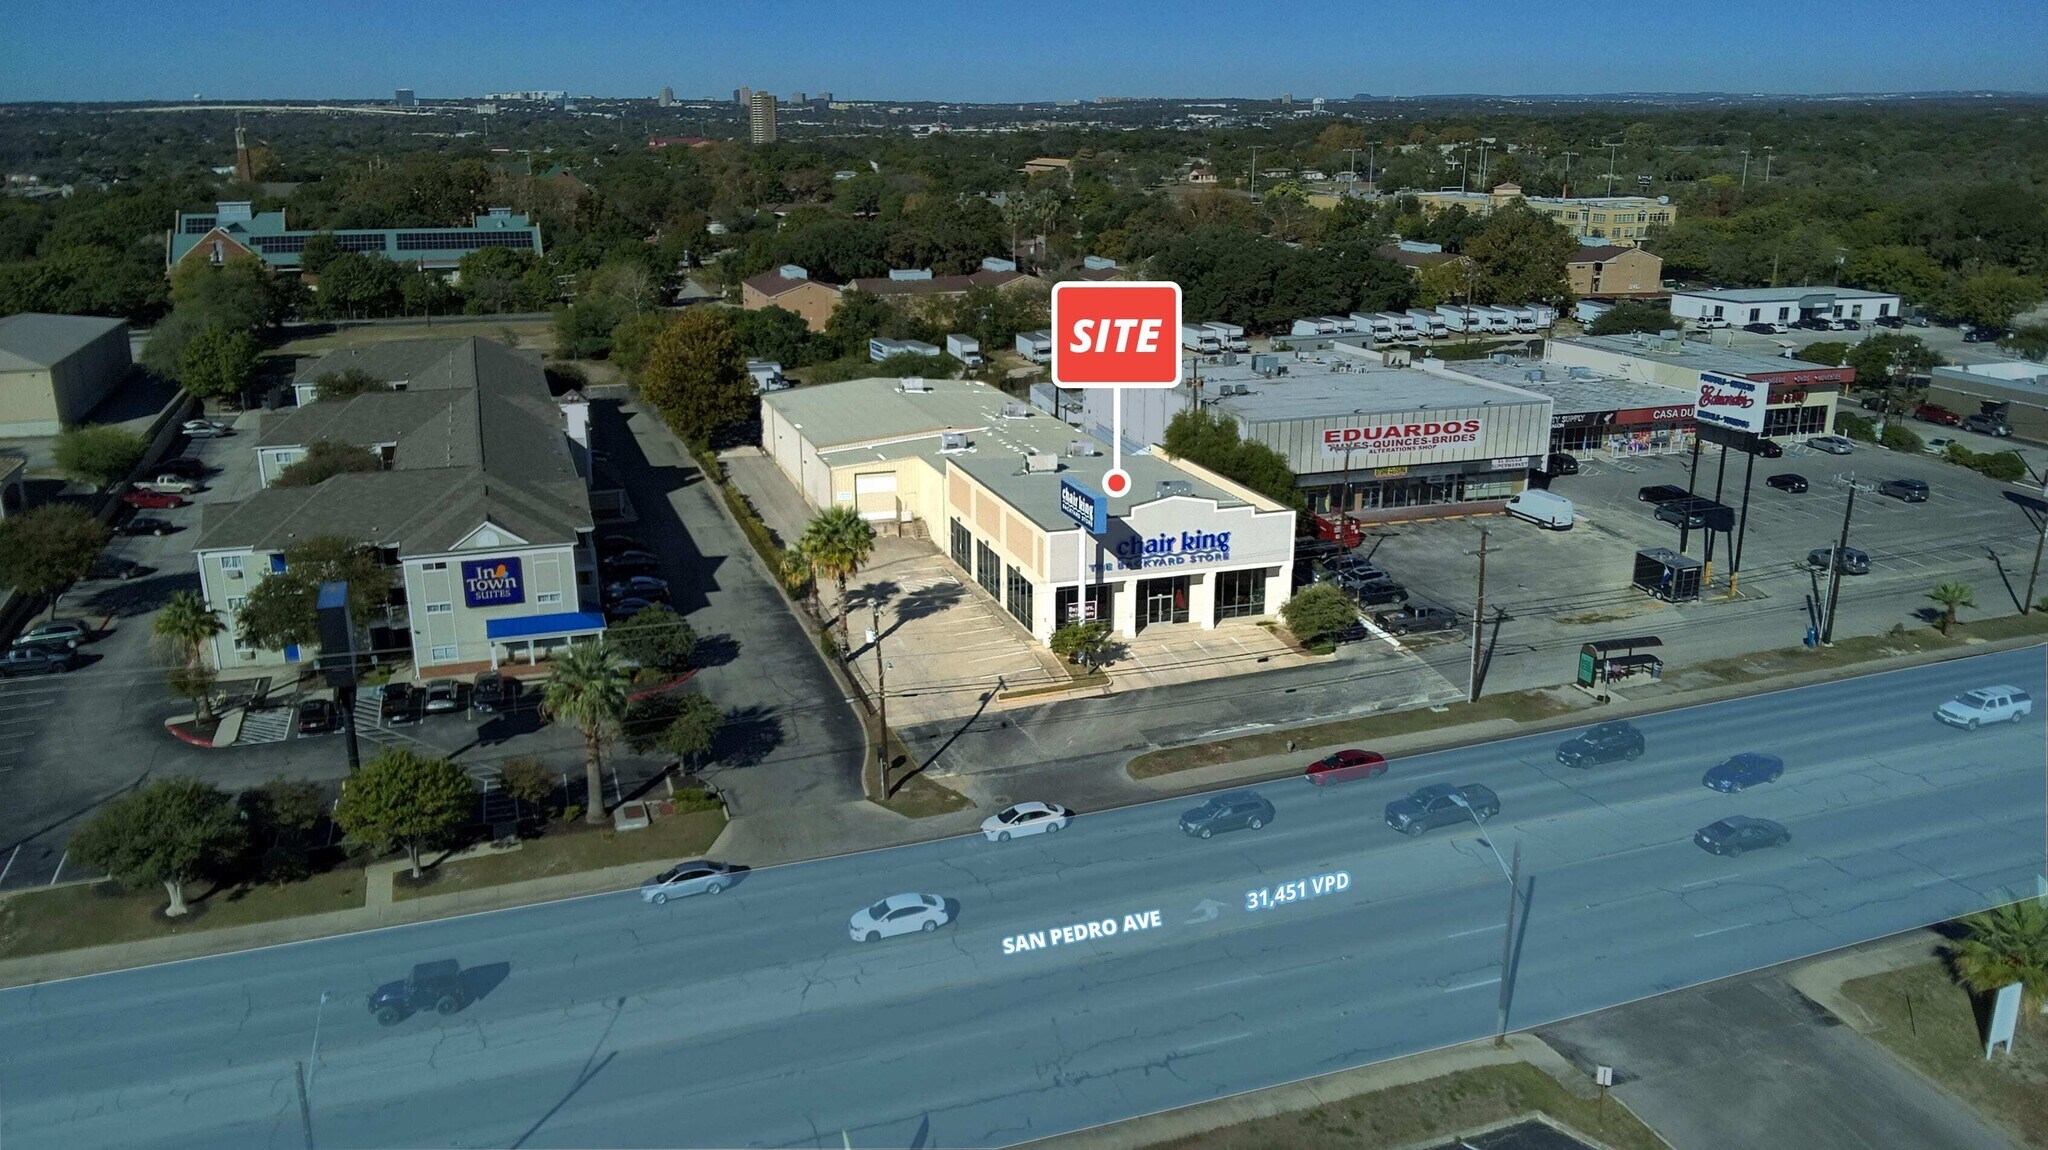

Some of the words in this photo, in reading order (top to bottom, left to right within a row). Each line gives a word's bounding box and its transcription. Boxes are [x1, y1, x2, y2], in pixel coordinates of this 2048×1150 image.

[1653, 410, 1679, 420] CASA
[1324, 420, 1480, 443] EDUARDOS
[1368, 445, 1416, 454] ALTERATIONS
[1062, 487, 1079, 508] chair
[1117, 533, 1177, 556] chair
[1182, 529, 1232, 553] king
[1118, 556, 1186, 572] BACKYARD
[1190, 552, 1230, 564] STORE
[476, 566, 496, 580] In
[475, 590, 511, 601] SUITES
